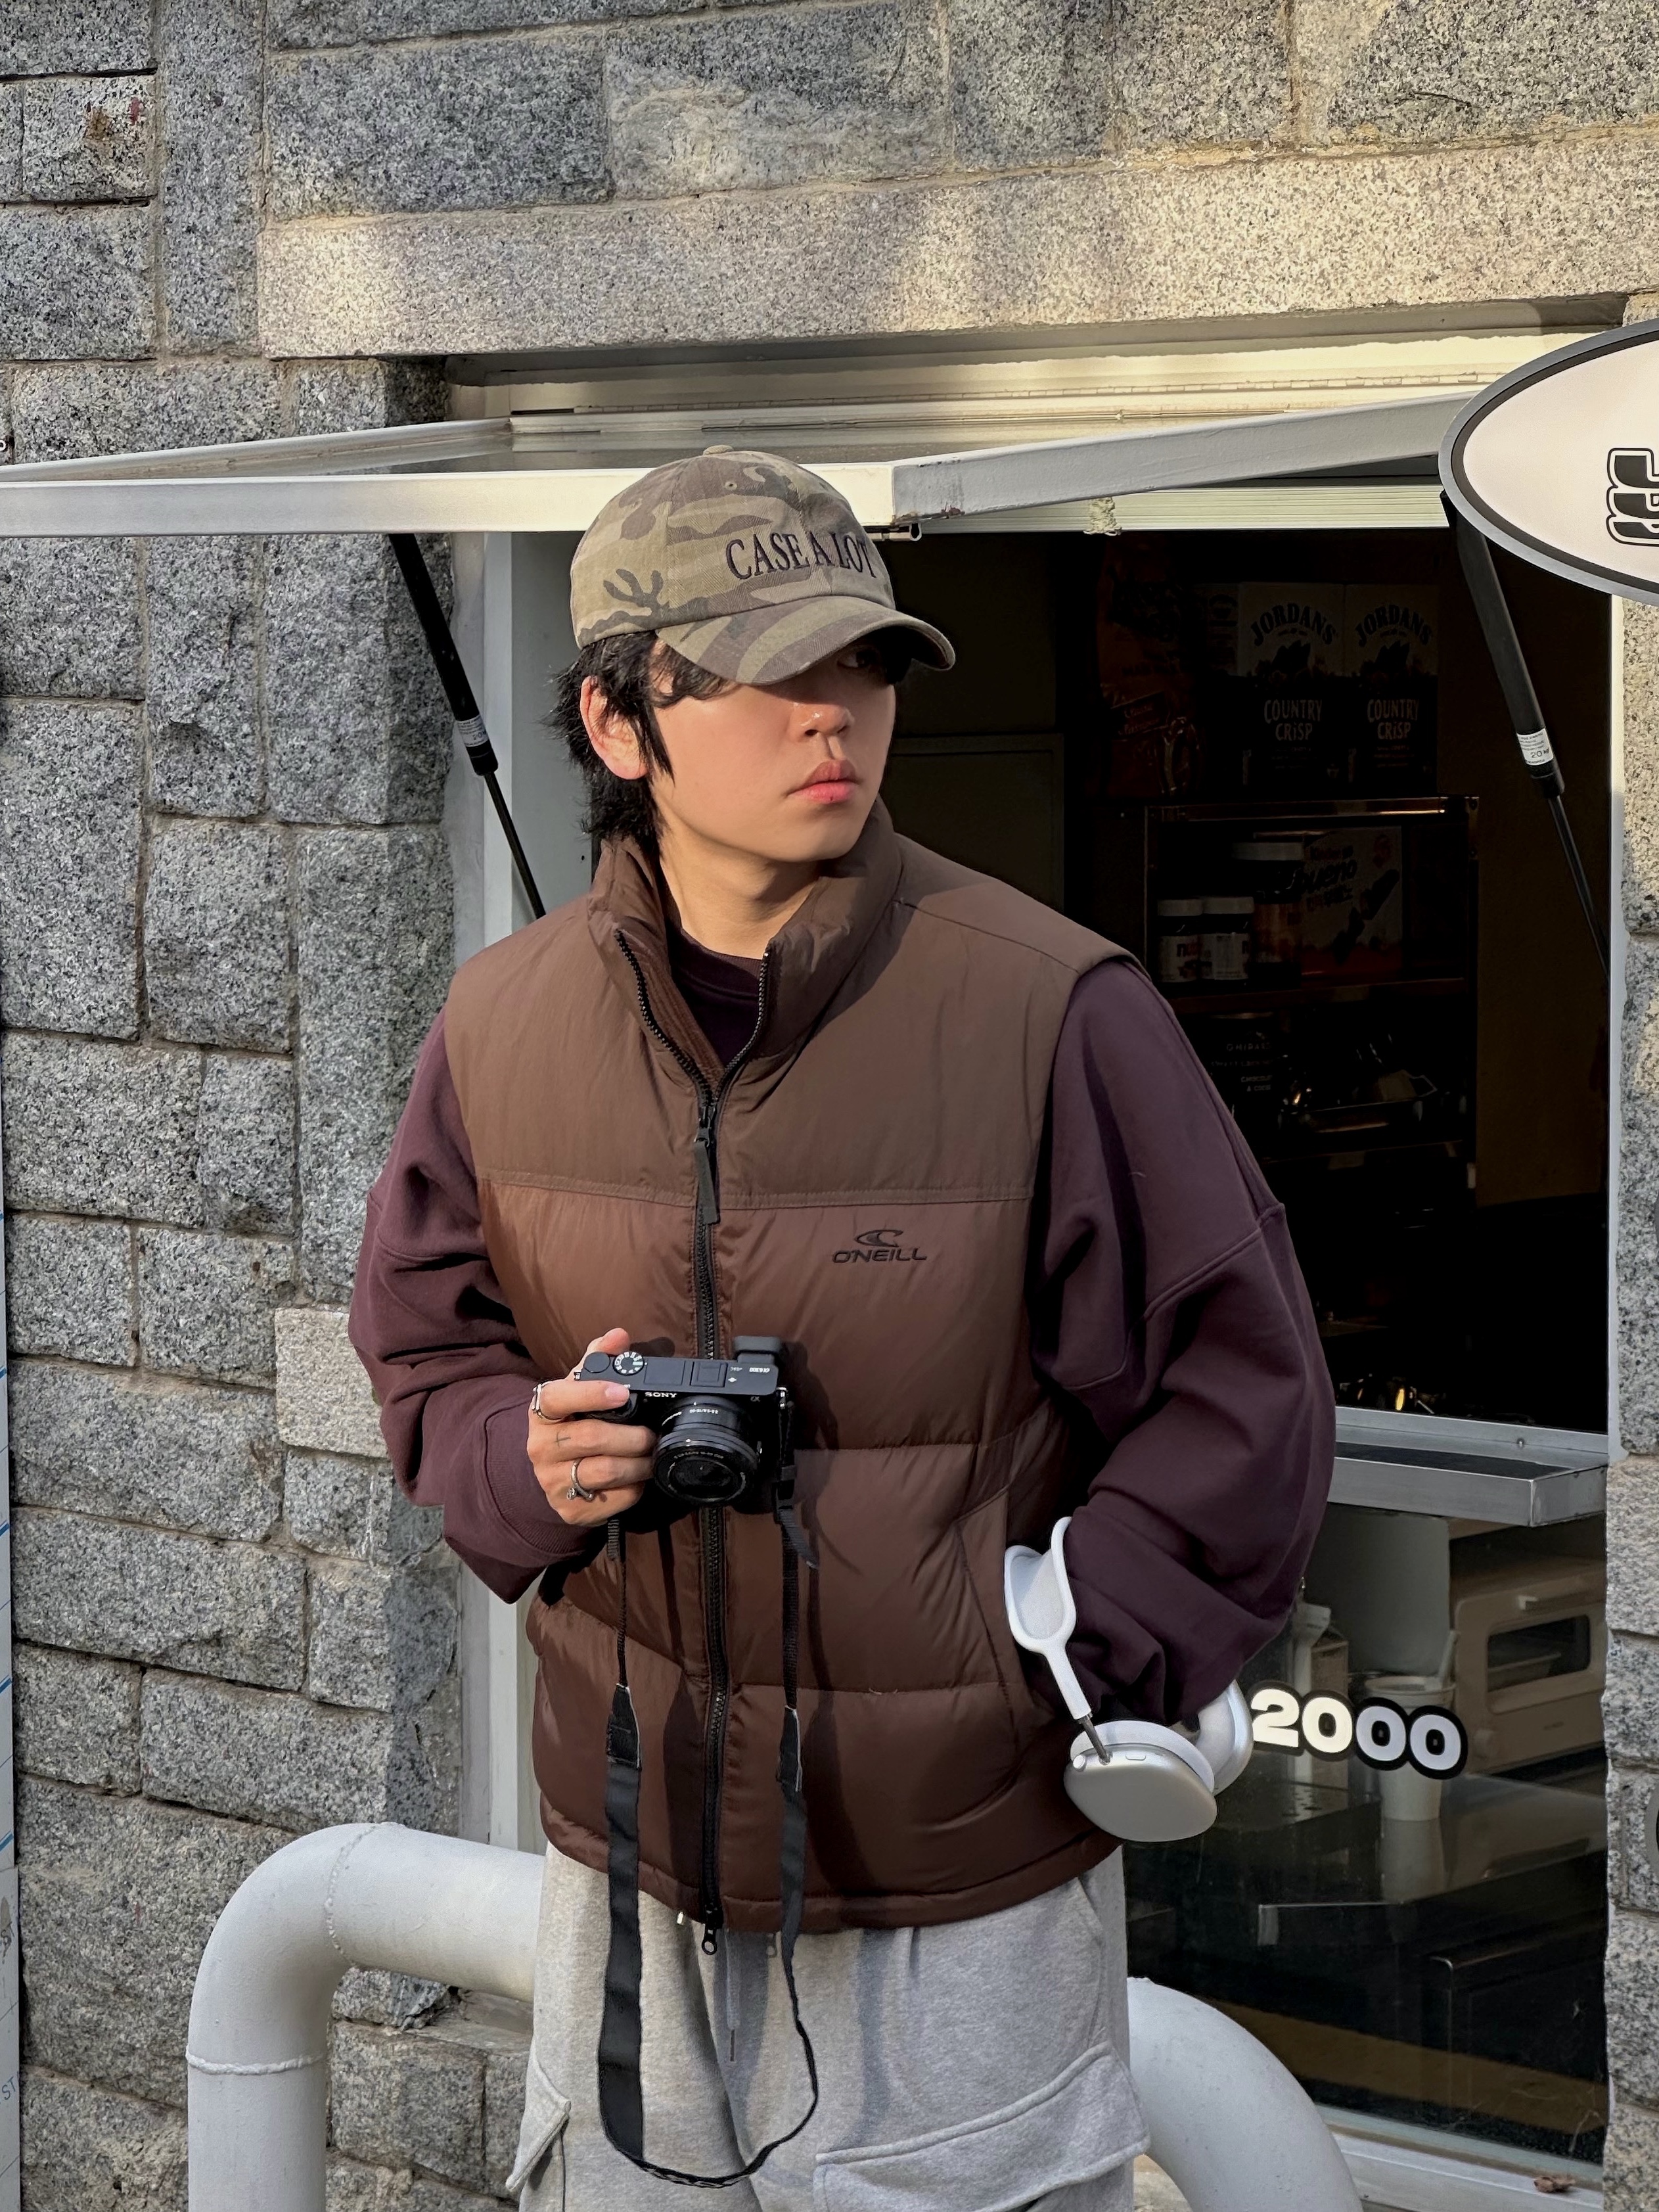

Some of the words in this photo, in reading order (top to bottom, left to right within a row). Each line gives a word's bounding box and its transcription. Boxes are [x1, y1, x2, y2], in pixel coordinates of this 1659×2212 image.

[725, 532, 810, 580] CASE
[809, 530, 836, 566] A
[1251, 603, 1336, 646] JORDANS
[1355, 604, 1431, 647] JORDANS
[1263, 699, 1323, 724] COUNTRY
[1367, 698, 1419, 723] COUNTRY
[1250, 1684, 1465, 1772] 2000
